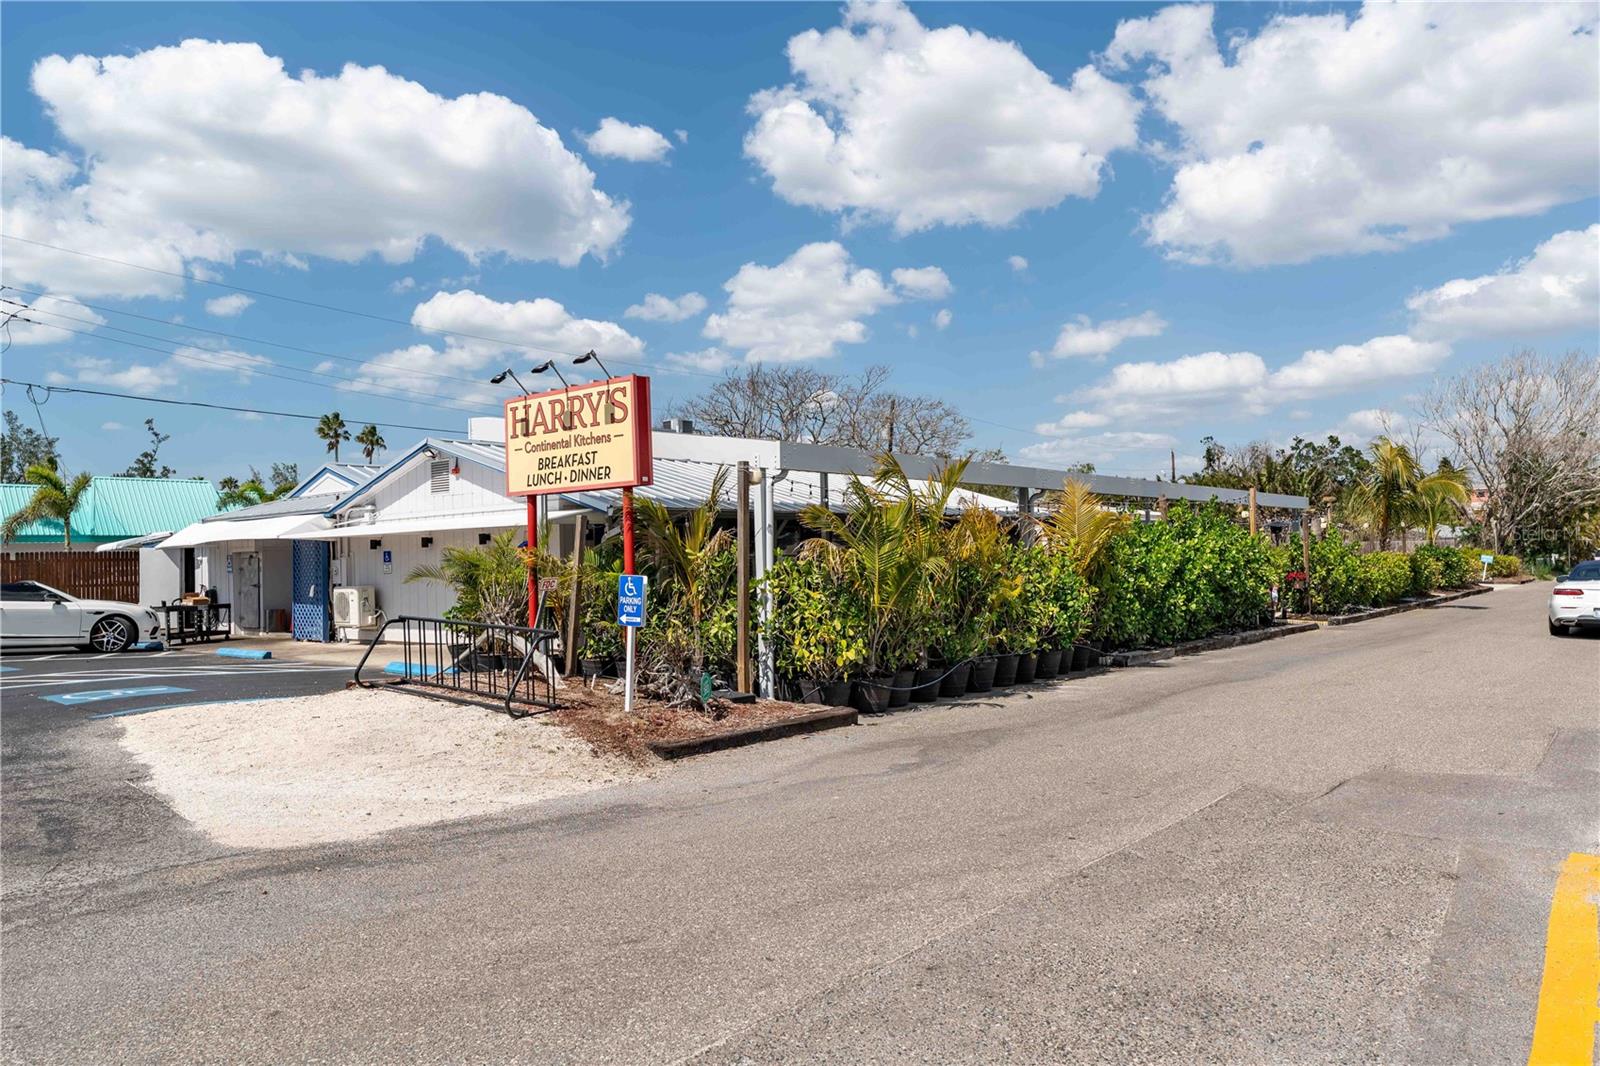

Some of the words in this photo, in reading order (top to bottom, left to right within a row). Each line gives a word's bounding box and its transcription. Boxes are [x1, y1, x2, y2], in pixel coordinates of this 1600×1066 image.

[510, 386, 629, 439] HARRY'S
[524, 435, 572, 454] Continental
[573, 433, 611, 448] Kitchens
[537, 451, 598, 471] BREAKFAST
[526, 472, 561, 487] LUNCH
[569, 466, 611, 483] DINNER
[620, 596, 642, 605] PARKING
[623, 605, 637, 613] ONLY
